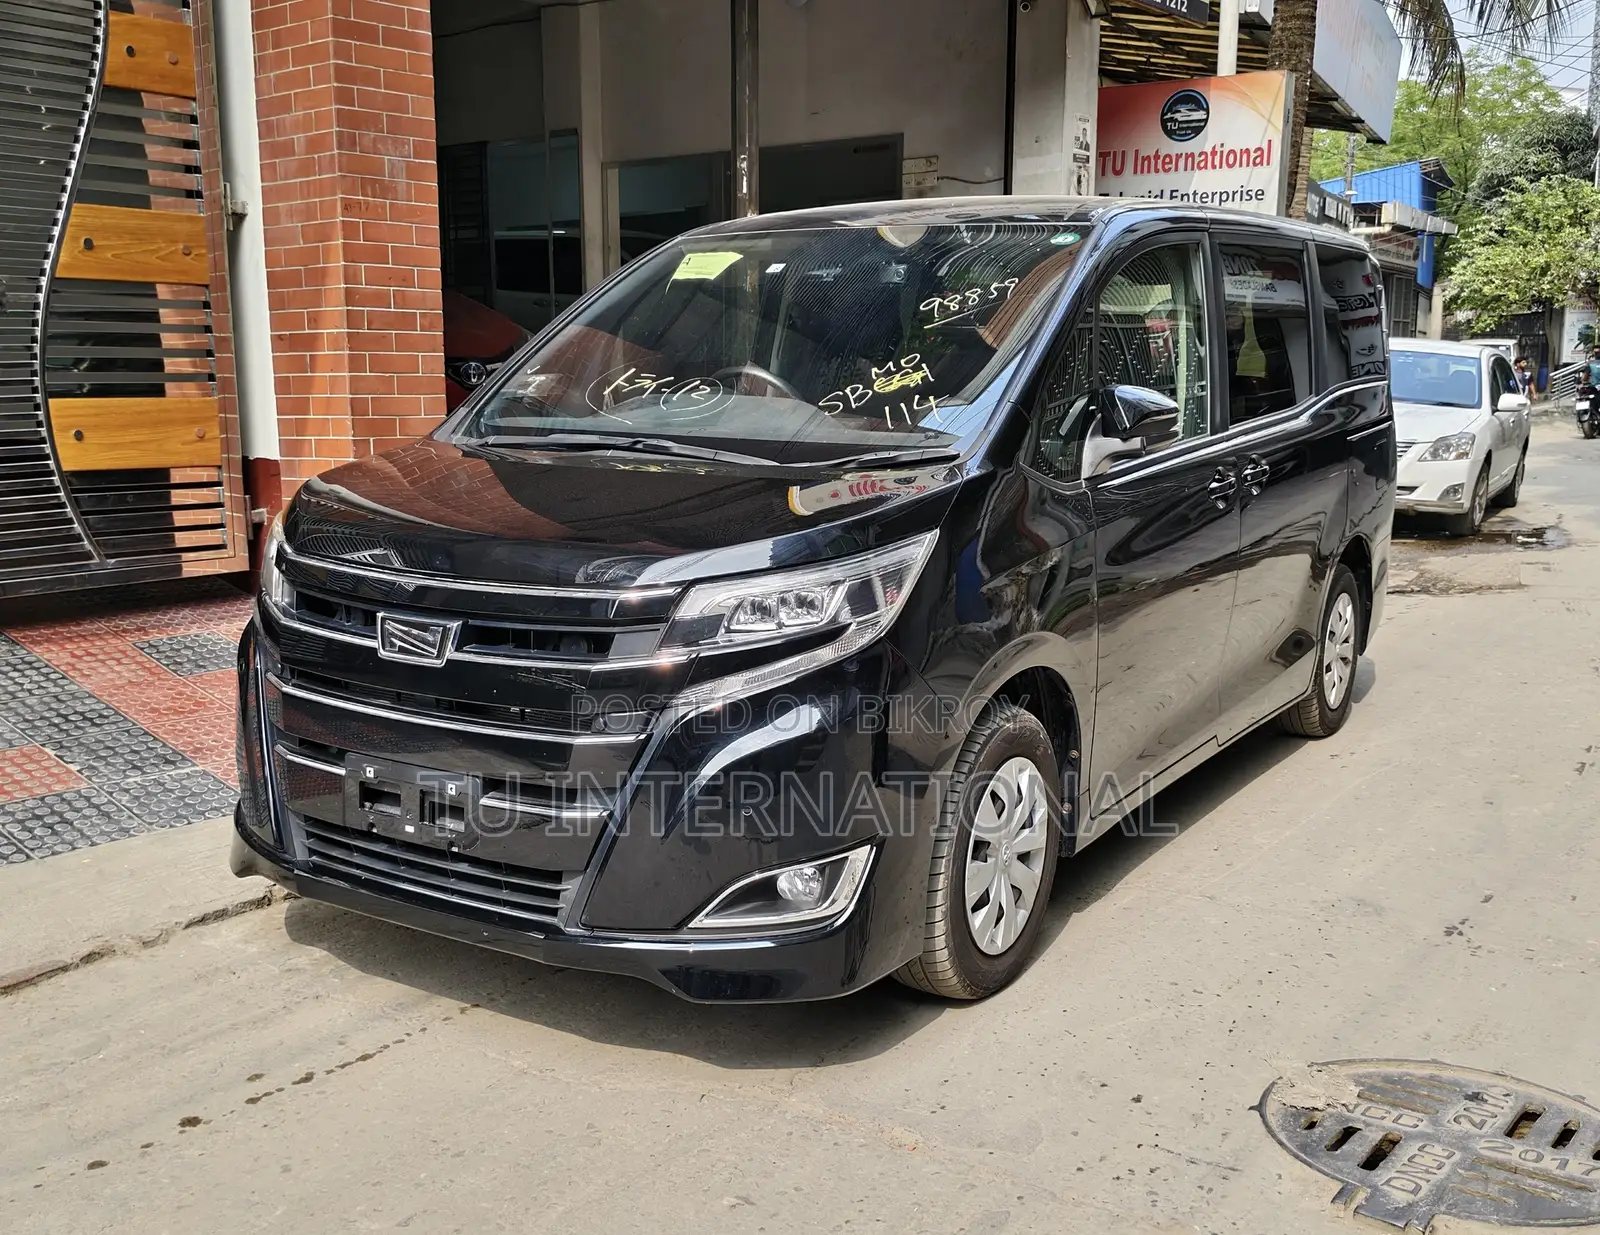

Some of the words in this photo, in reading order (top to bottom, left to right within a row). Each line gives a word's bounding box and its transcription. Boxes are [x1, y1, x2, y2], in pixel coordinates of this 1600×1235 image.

[1167, 122, 1178, 130] TU
[1098, 150, 1126, 177] TU
[1133, 140, 1272, 175] International
[1169, 185, 1265, 206] Enterprise
[818, 384, 873, 415] SB
[884, 394, 950, 429] 114
[1380, 1143, 1456, 1197] DNCC
